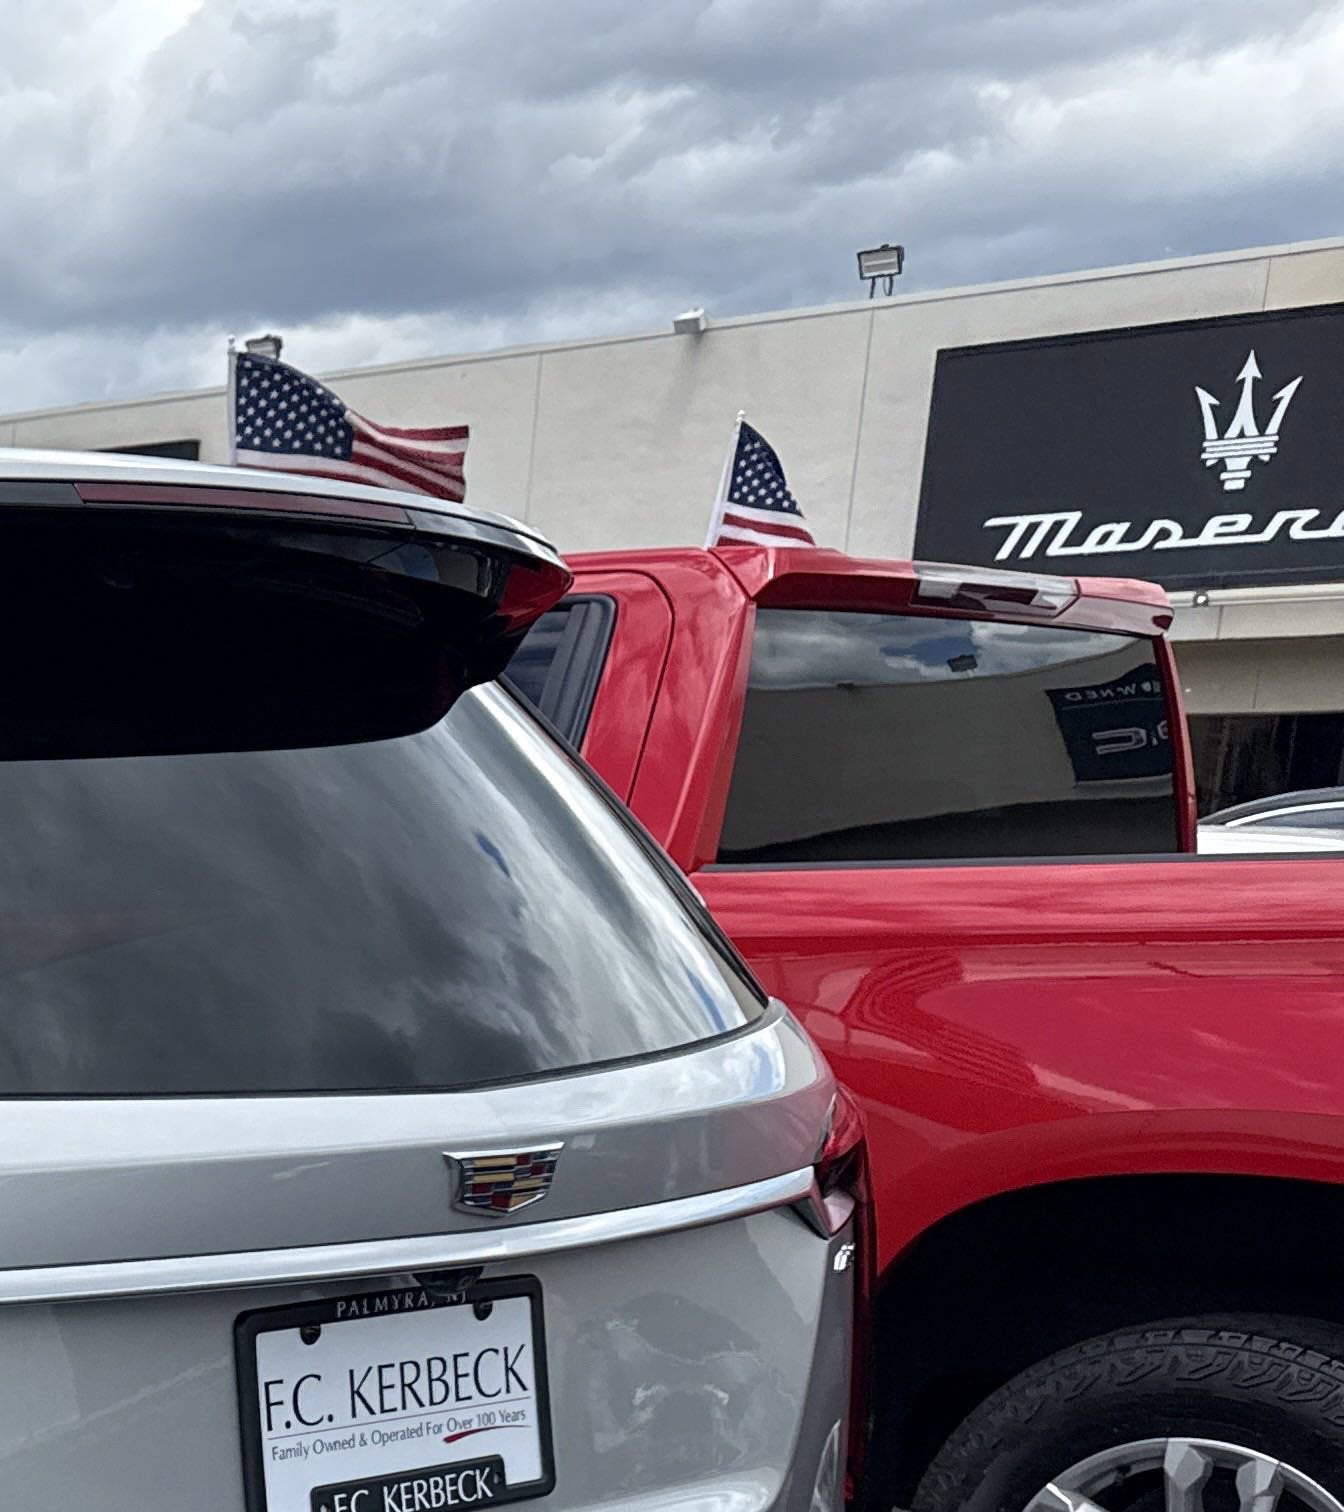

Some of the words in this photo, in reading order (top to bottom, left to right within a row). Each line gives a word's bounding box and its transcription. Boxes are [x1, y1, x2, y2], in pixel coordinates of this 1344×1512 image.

[264, 1374, 334, 1432] F.C.
[349, 1344, 528, 1419] KERBECK
[272, 1441, 310, 1461] Family
[313, 1433, 356, 1455] Owned
[359, 1432, 368, 1447] &
[371, 1422, 423, 1447] Operated
[426, 1421, 443, 1436] For
[447, 1417, 473, 1433] Over
[477, 1413, 496, 1426] 100
[498, 1409, 526, 1424] Years
